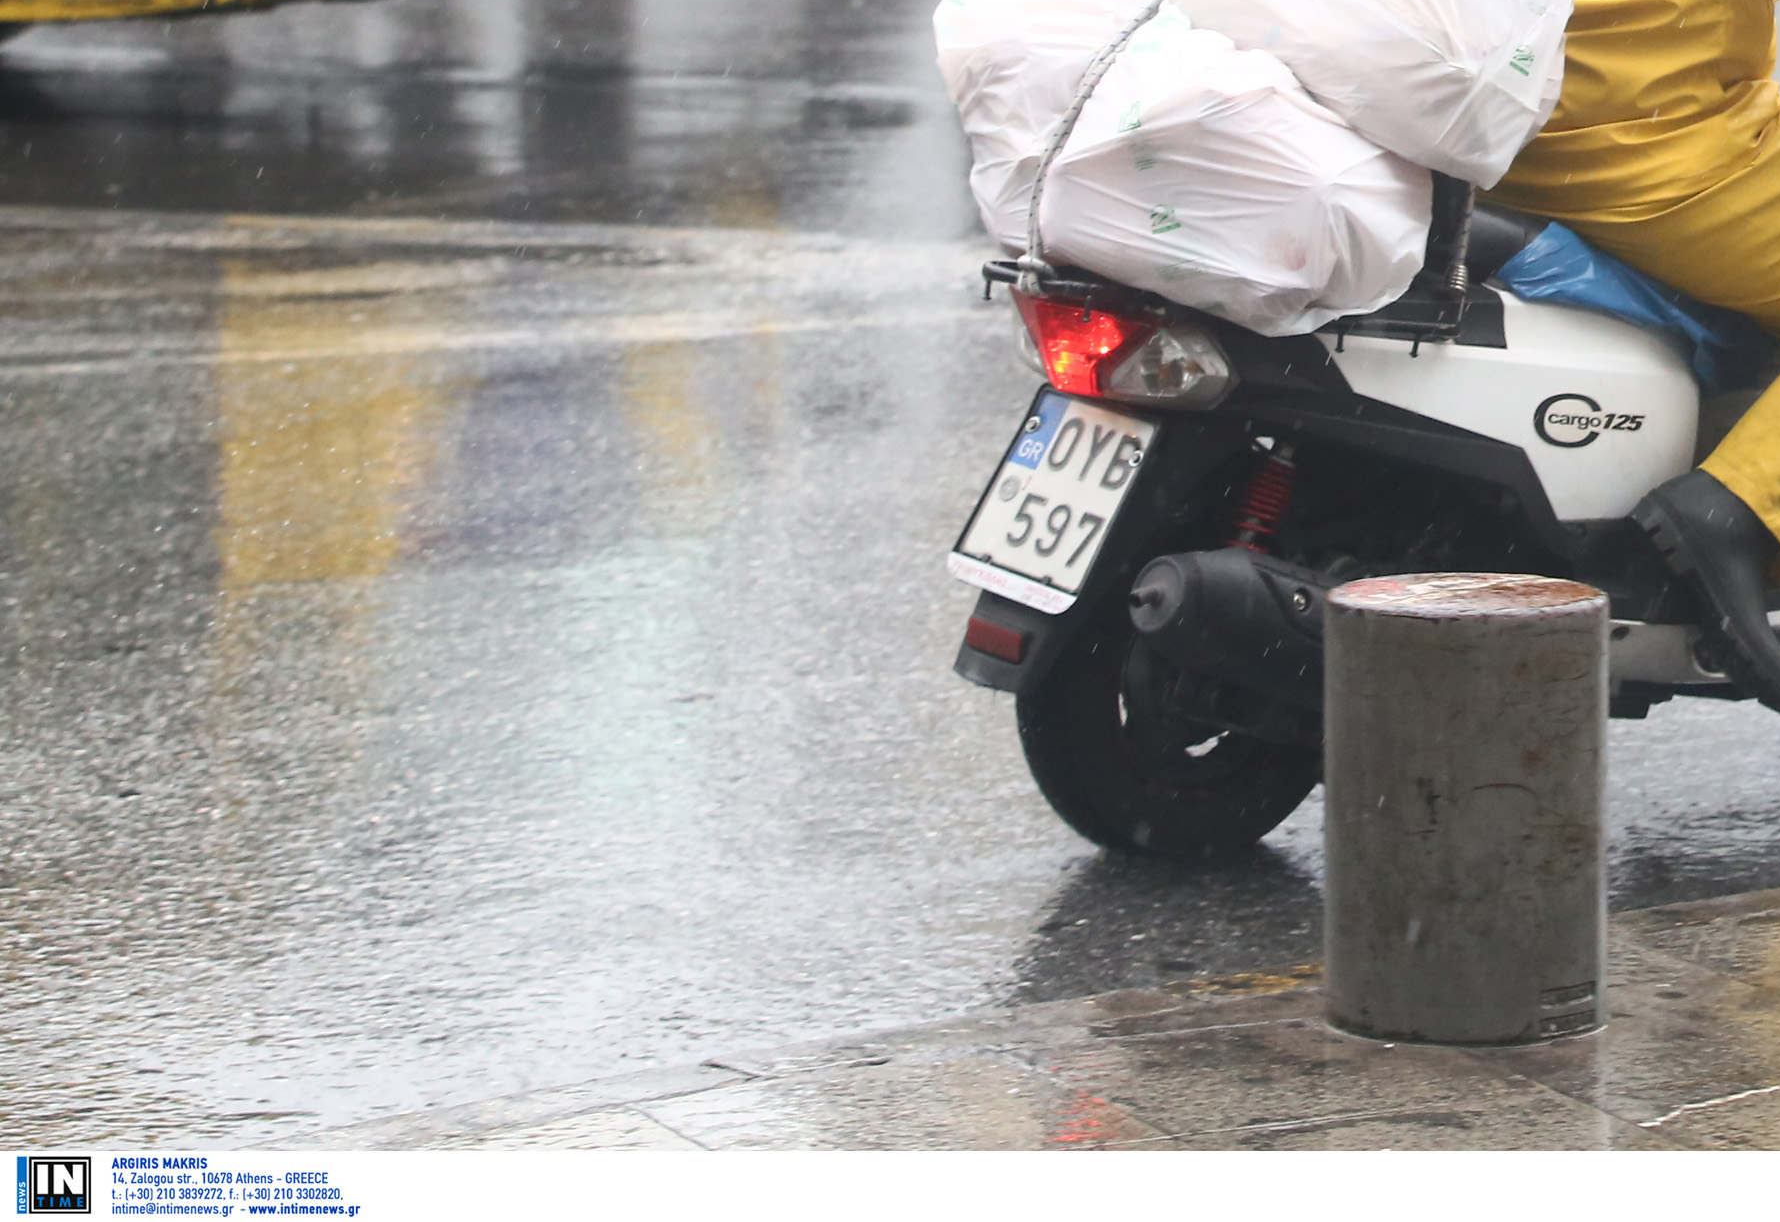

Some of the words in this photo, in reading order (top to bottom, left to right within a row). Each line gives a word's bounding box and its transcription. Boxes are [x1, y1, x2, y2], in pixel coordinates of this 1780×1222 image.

[1547, 413, 1602, 430] cargo
[1603, 413, 1645, 431] 125
[1017, 438, 1043, 462] GR
[1005, 492, 1107, 569] 597
